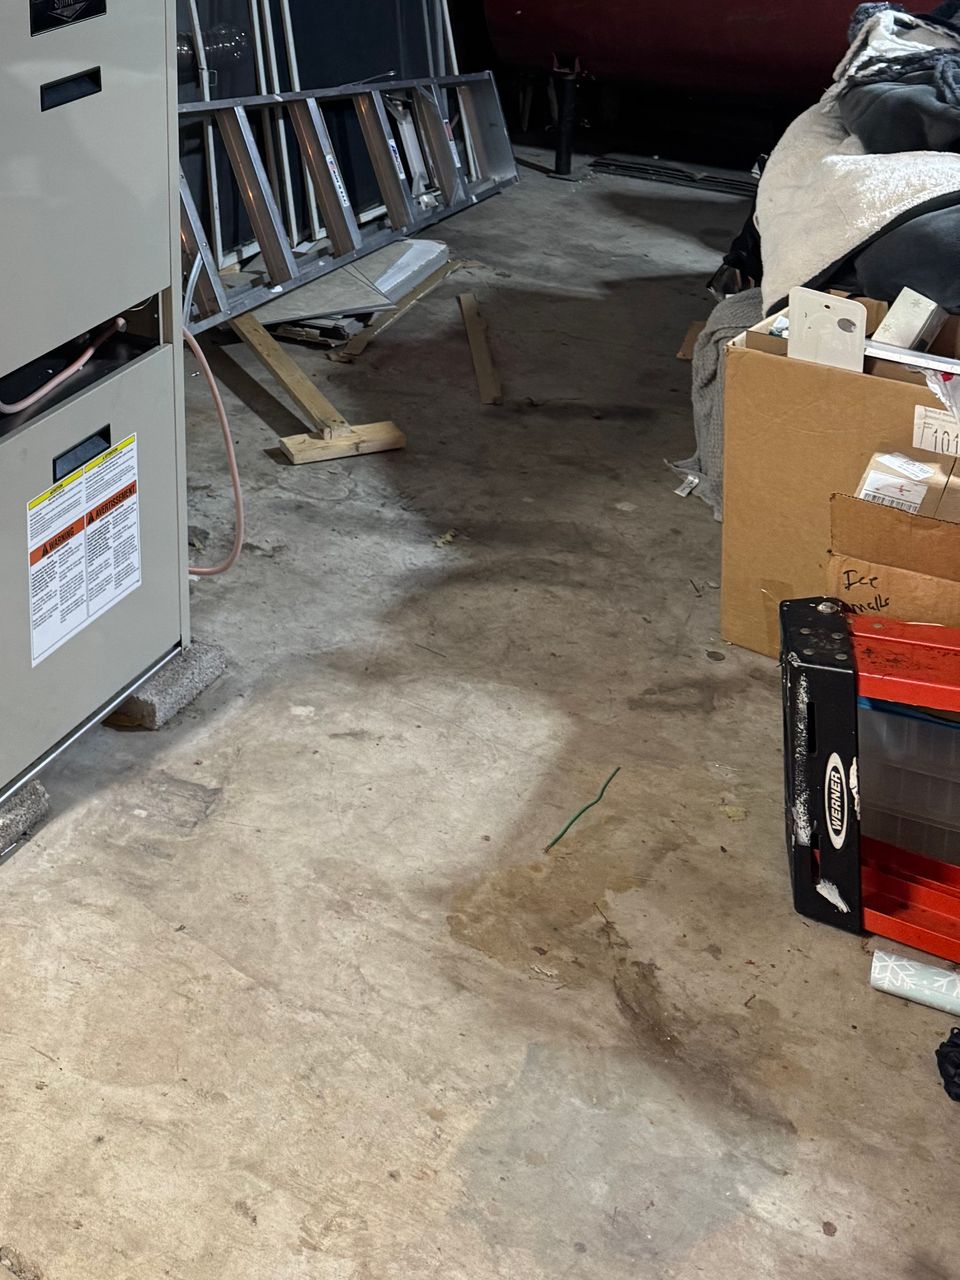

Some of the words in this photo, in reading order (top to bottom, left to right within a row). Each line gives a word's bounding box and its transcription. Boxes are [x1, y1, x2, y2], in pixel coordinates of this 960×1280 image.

[95, 483, 136, 520] AVERTISSEMENT
[48, 526, 75, 551] WARNING
[843, 569, 879, 591] Ice
[830, 770, 842, 831] WERNER
